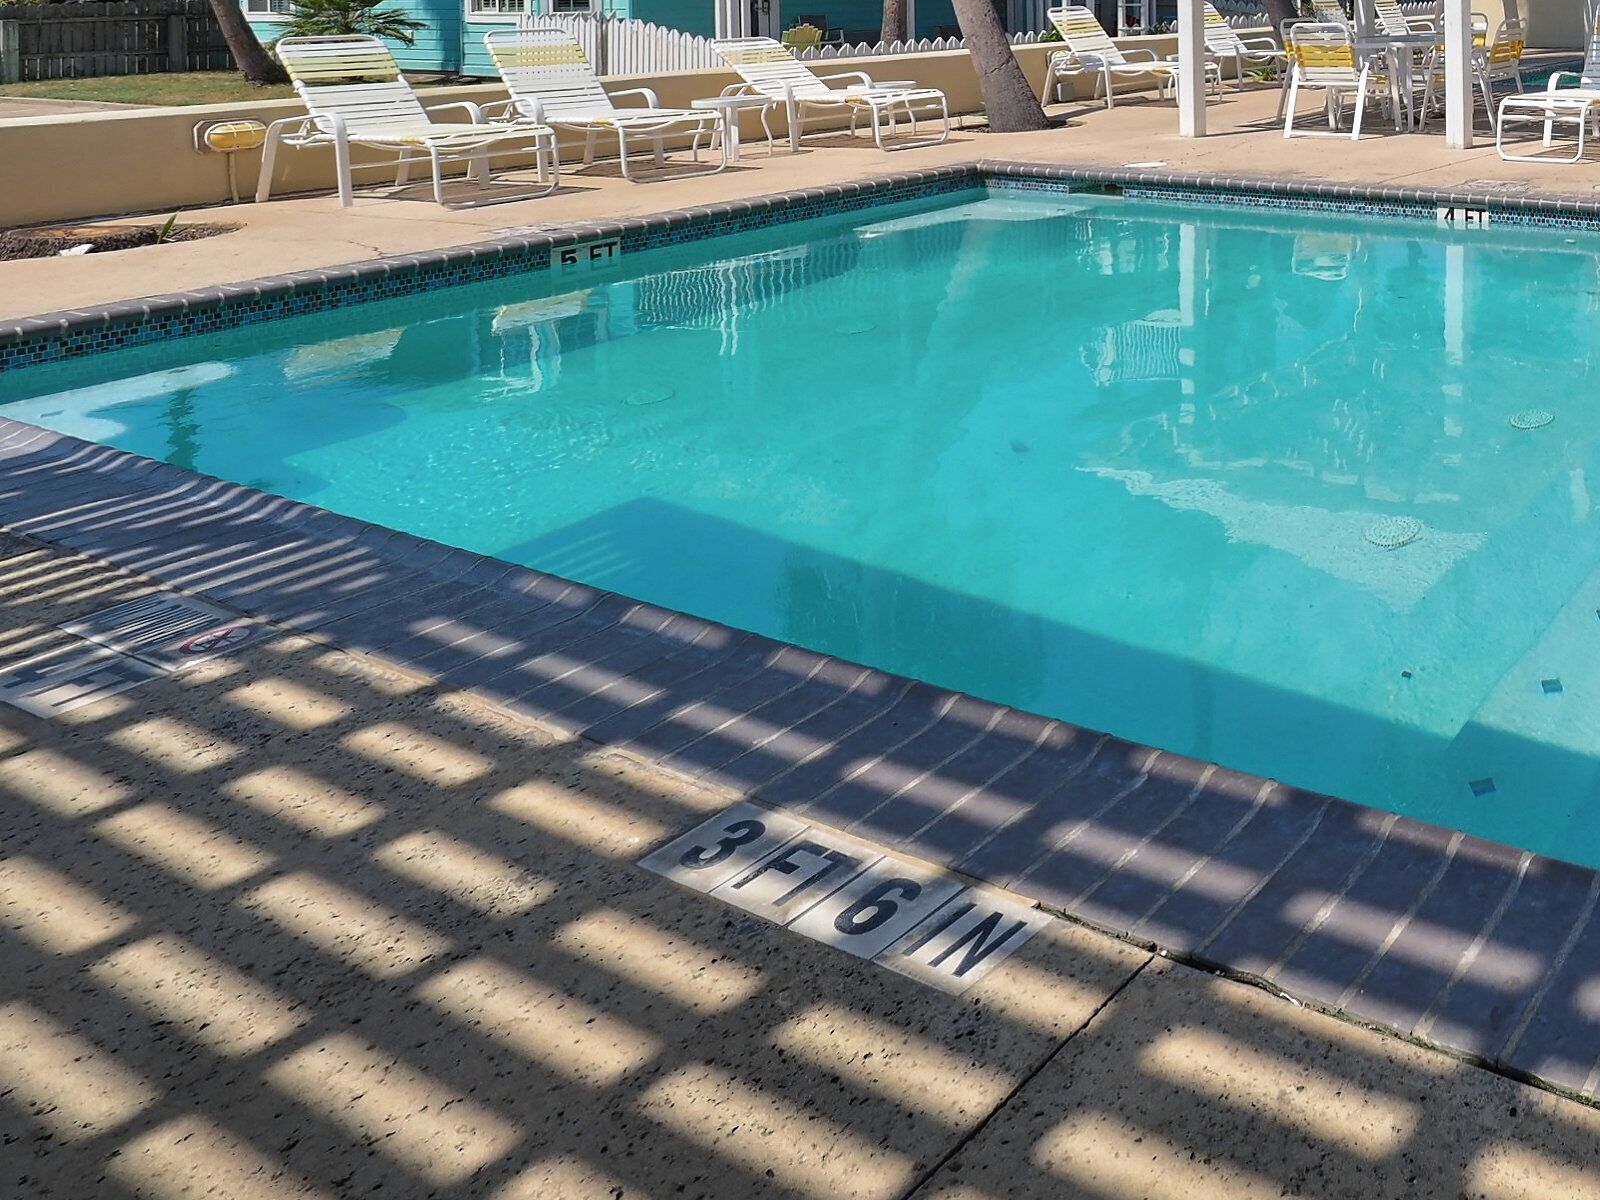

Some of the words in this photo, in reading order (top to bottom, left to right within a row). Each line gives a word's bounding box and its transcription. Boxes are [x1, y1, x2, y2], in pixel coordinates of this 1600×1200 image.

[1465, 208, 1487, 223] FT
[560, 248, 578, 266] 5
[589, 241, 619, 261] FT
[20, 660, 154, 708] FT
[679, 818, 767, 869] 3
[731, 839, 864, 908] FT
[833, 877, 923, 935] 6
[903, 901, 1028, 979] IN
